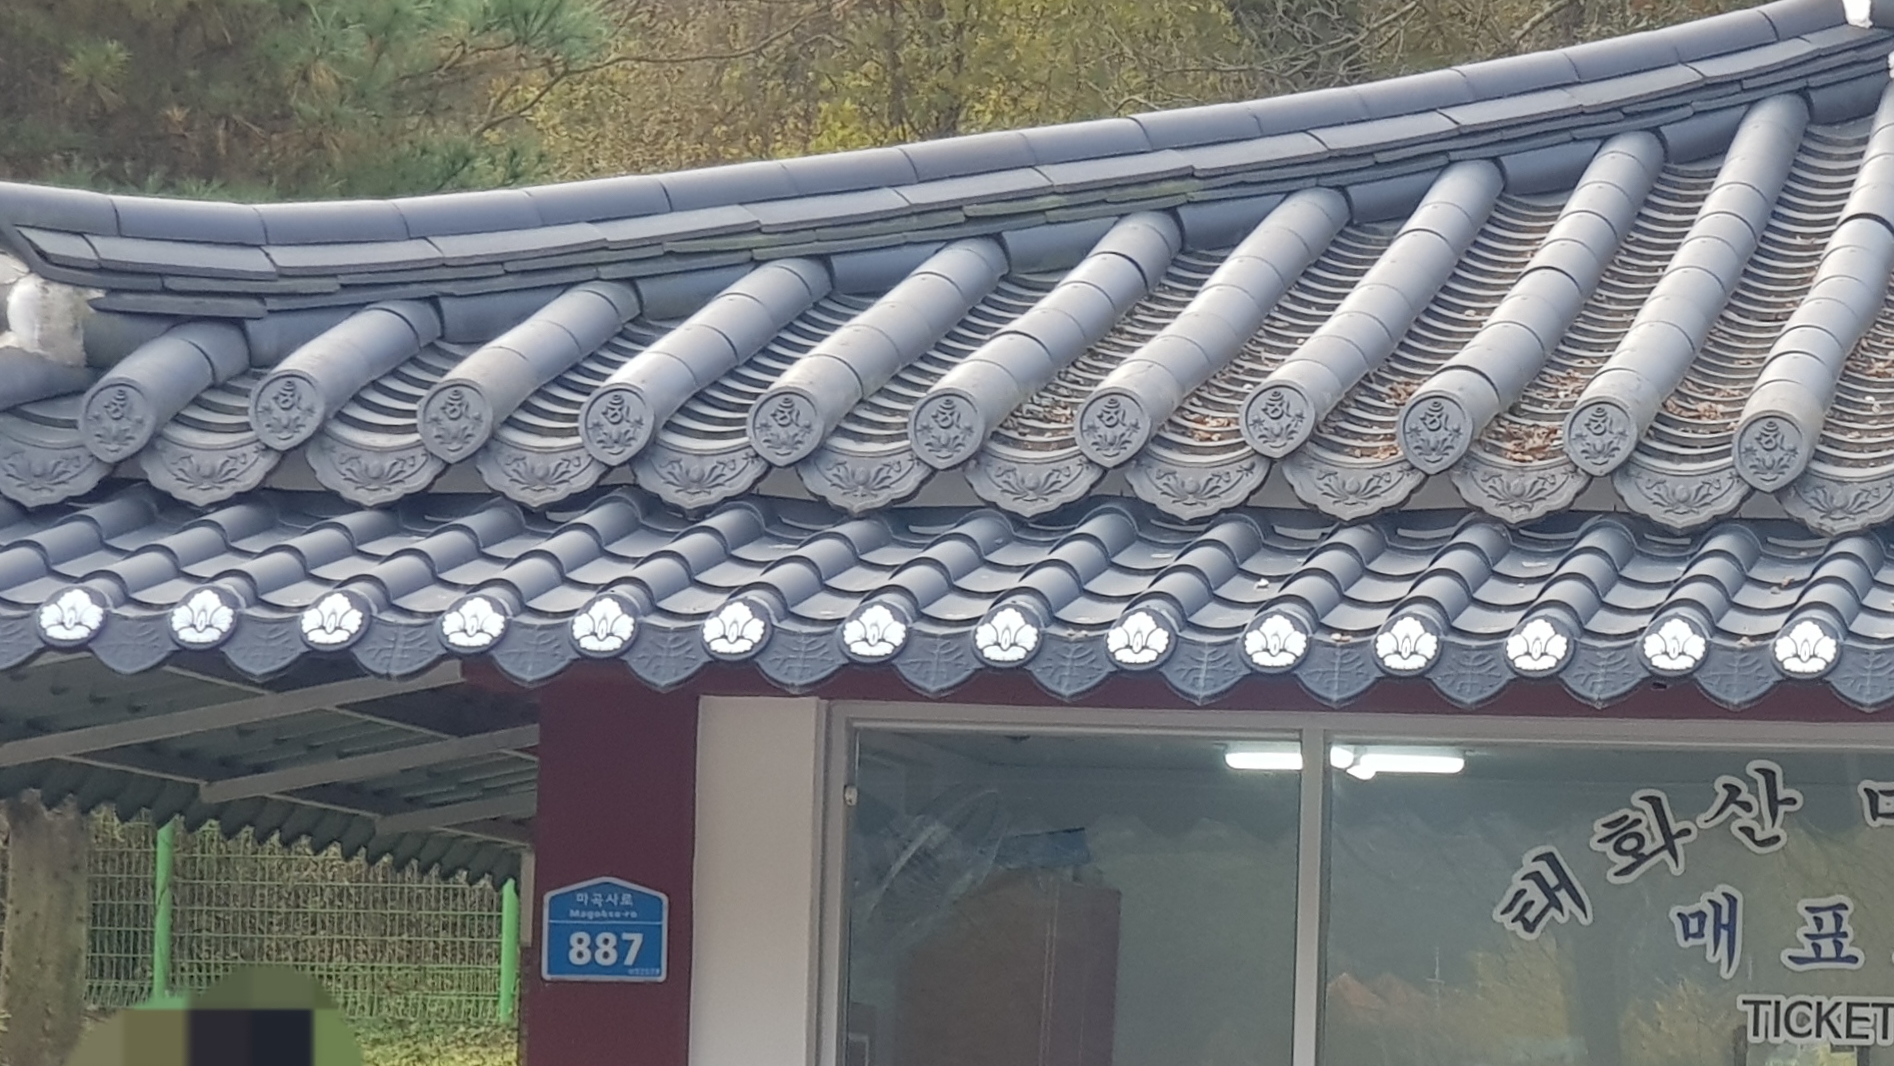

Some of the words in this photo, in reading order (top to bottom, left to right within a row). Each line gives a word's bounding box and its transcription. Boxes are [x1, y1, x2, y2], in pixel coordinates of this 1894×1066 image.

[1498, 763, 1797, 937] 태화산
[576, 893, 633, 907] 마곡사로
[568, 931, 644, 966] 887
